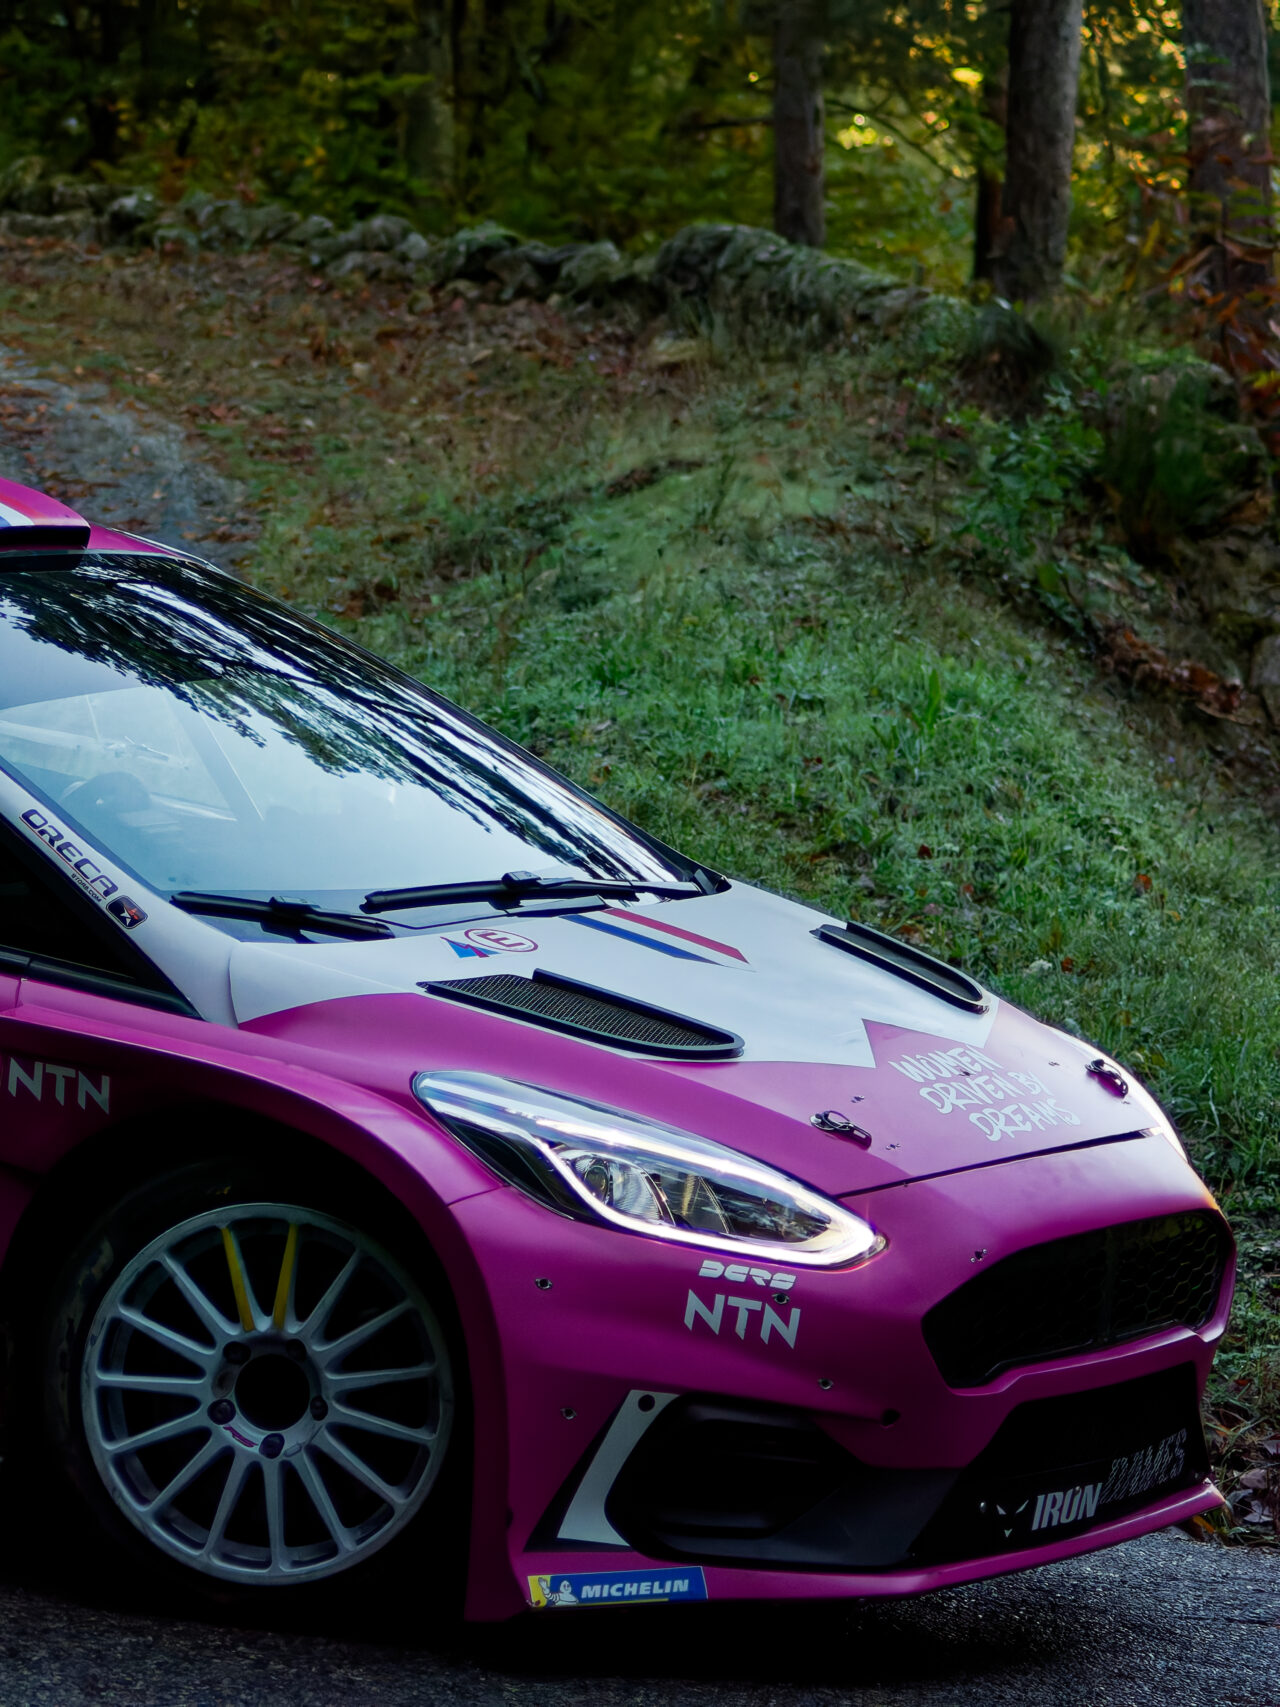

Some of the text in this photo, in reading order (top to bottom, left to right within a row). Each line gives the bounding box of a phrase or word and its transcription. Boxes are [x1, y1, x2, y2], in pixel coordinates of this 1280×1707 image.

[21, 809, 118, 897] ORECA
[8, 1057, 110, 1115] NTN
[888, 1044, 1005, 1083] WOMEN
[919, 1071, 1054, 1114] DRIVEN BY
[969, 1098, 1081, 1142] DREAMS
[684, 1288, 801, 1349] NTN
[1032, 1482, 1103, 1531] IRON
[581, 1579, 690, 1599] MICHELIN
